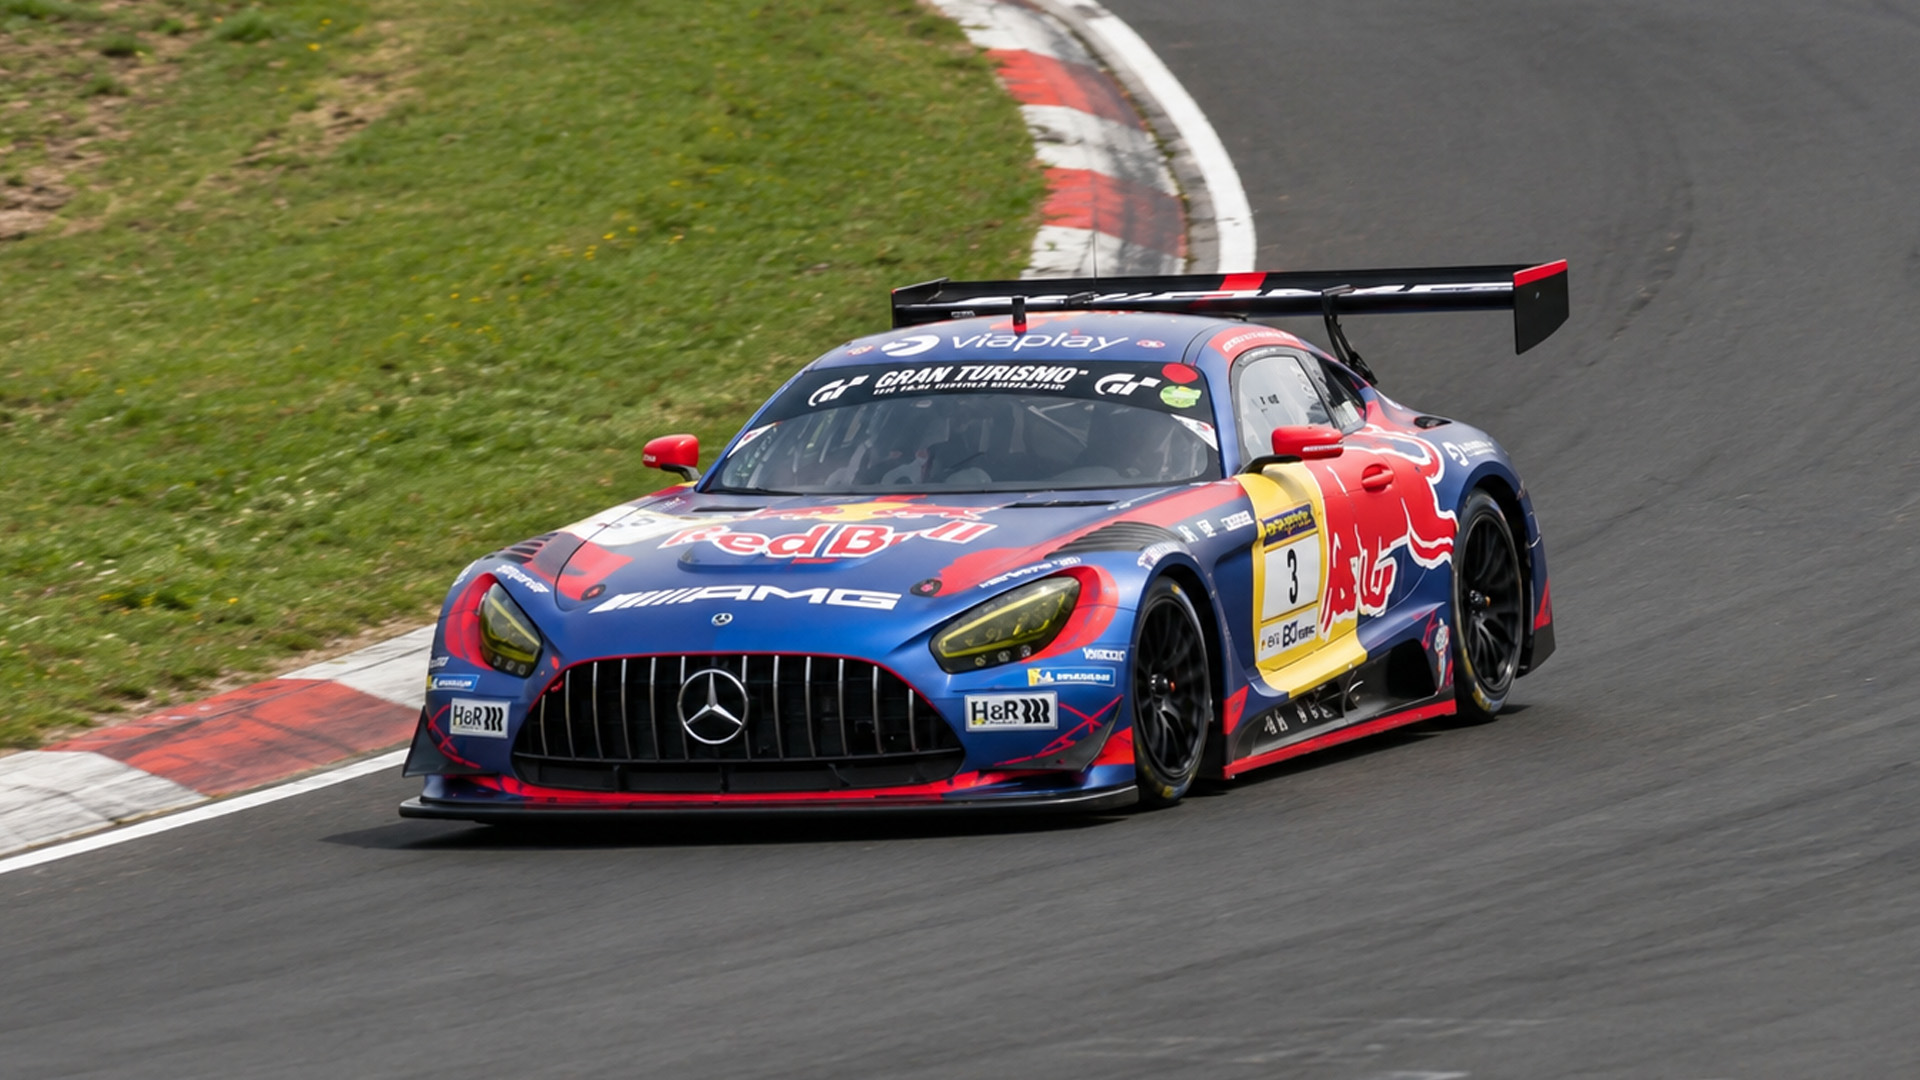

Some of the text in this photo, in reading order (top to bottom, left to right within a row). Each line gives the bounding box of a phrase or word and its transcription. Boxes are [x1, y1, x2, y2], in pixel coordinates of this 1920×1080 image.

[952, 332, 1128, 352] viaplay
[875, 365, 1079, 388] GRAN TURISMO
[657, 523, 836, 558] Red
[1286, 548, 1299, 605] 3
[453, 705, 482, 726] H&R
[971, 700, 1019, 720] H&R
